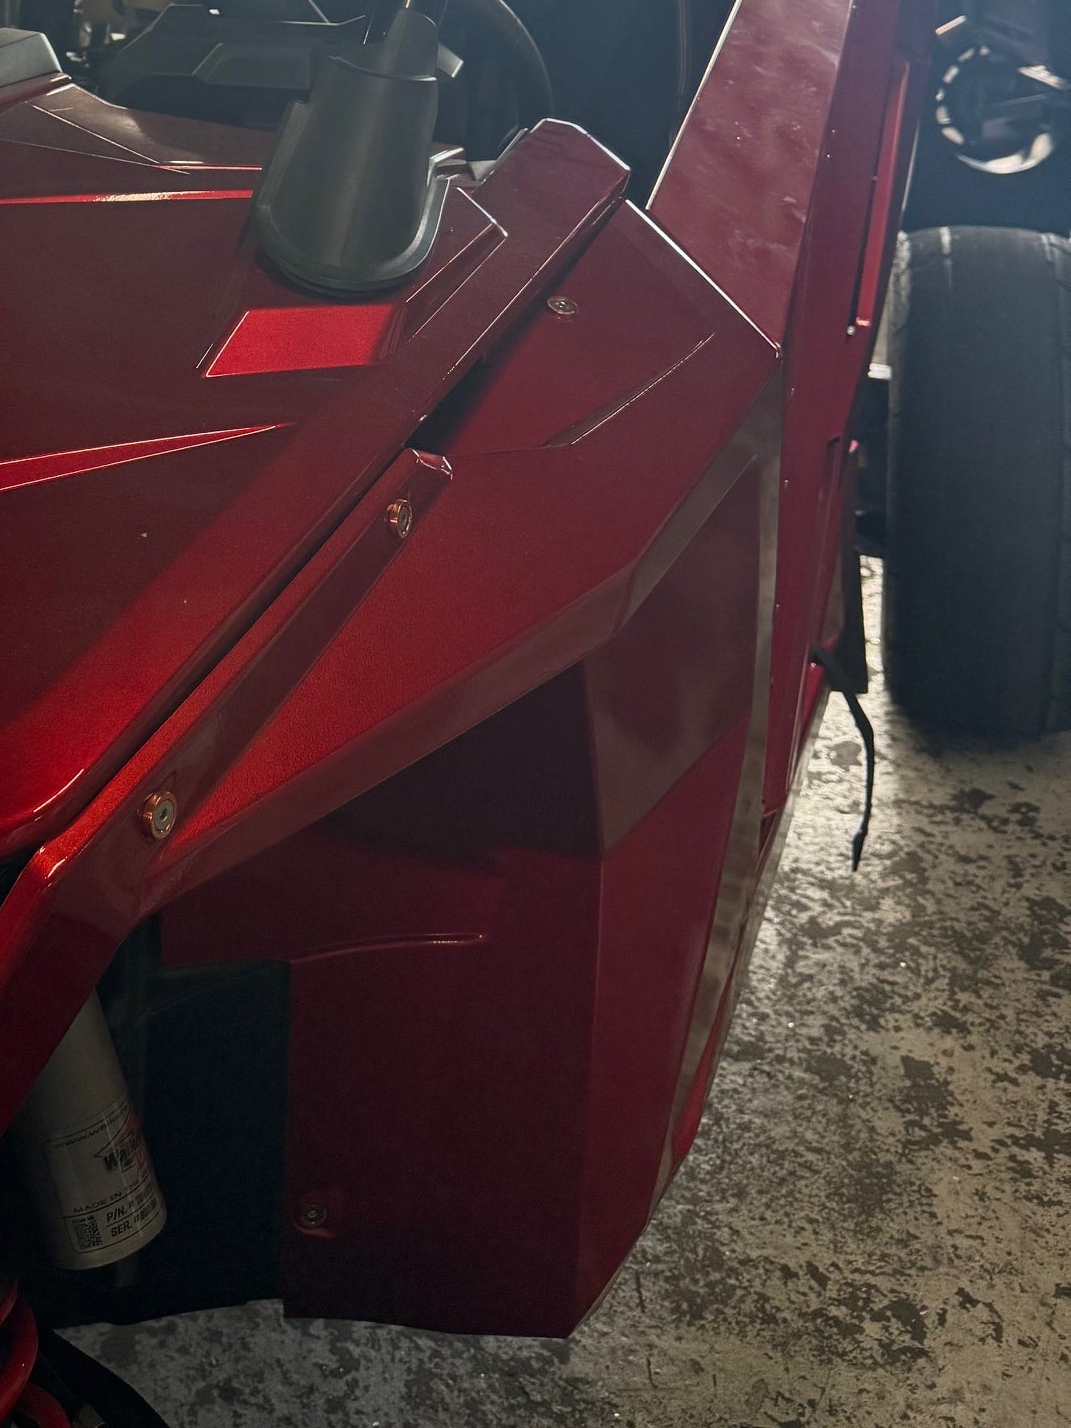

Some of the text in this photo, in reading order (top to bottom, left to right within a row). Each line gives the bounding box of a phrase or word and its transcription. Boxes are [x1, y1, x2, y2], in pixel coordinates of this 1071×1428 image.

[73, 1200, 106, 1213] MADE
[110, 1191, 122, 1200] IN
[106, 1205, 128, 1222] P/N.
